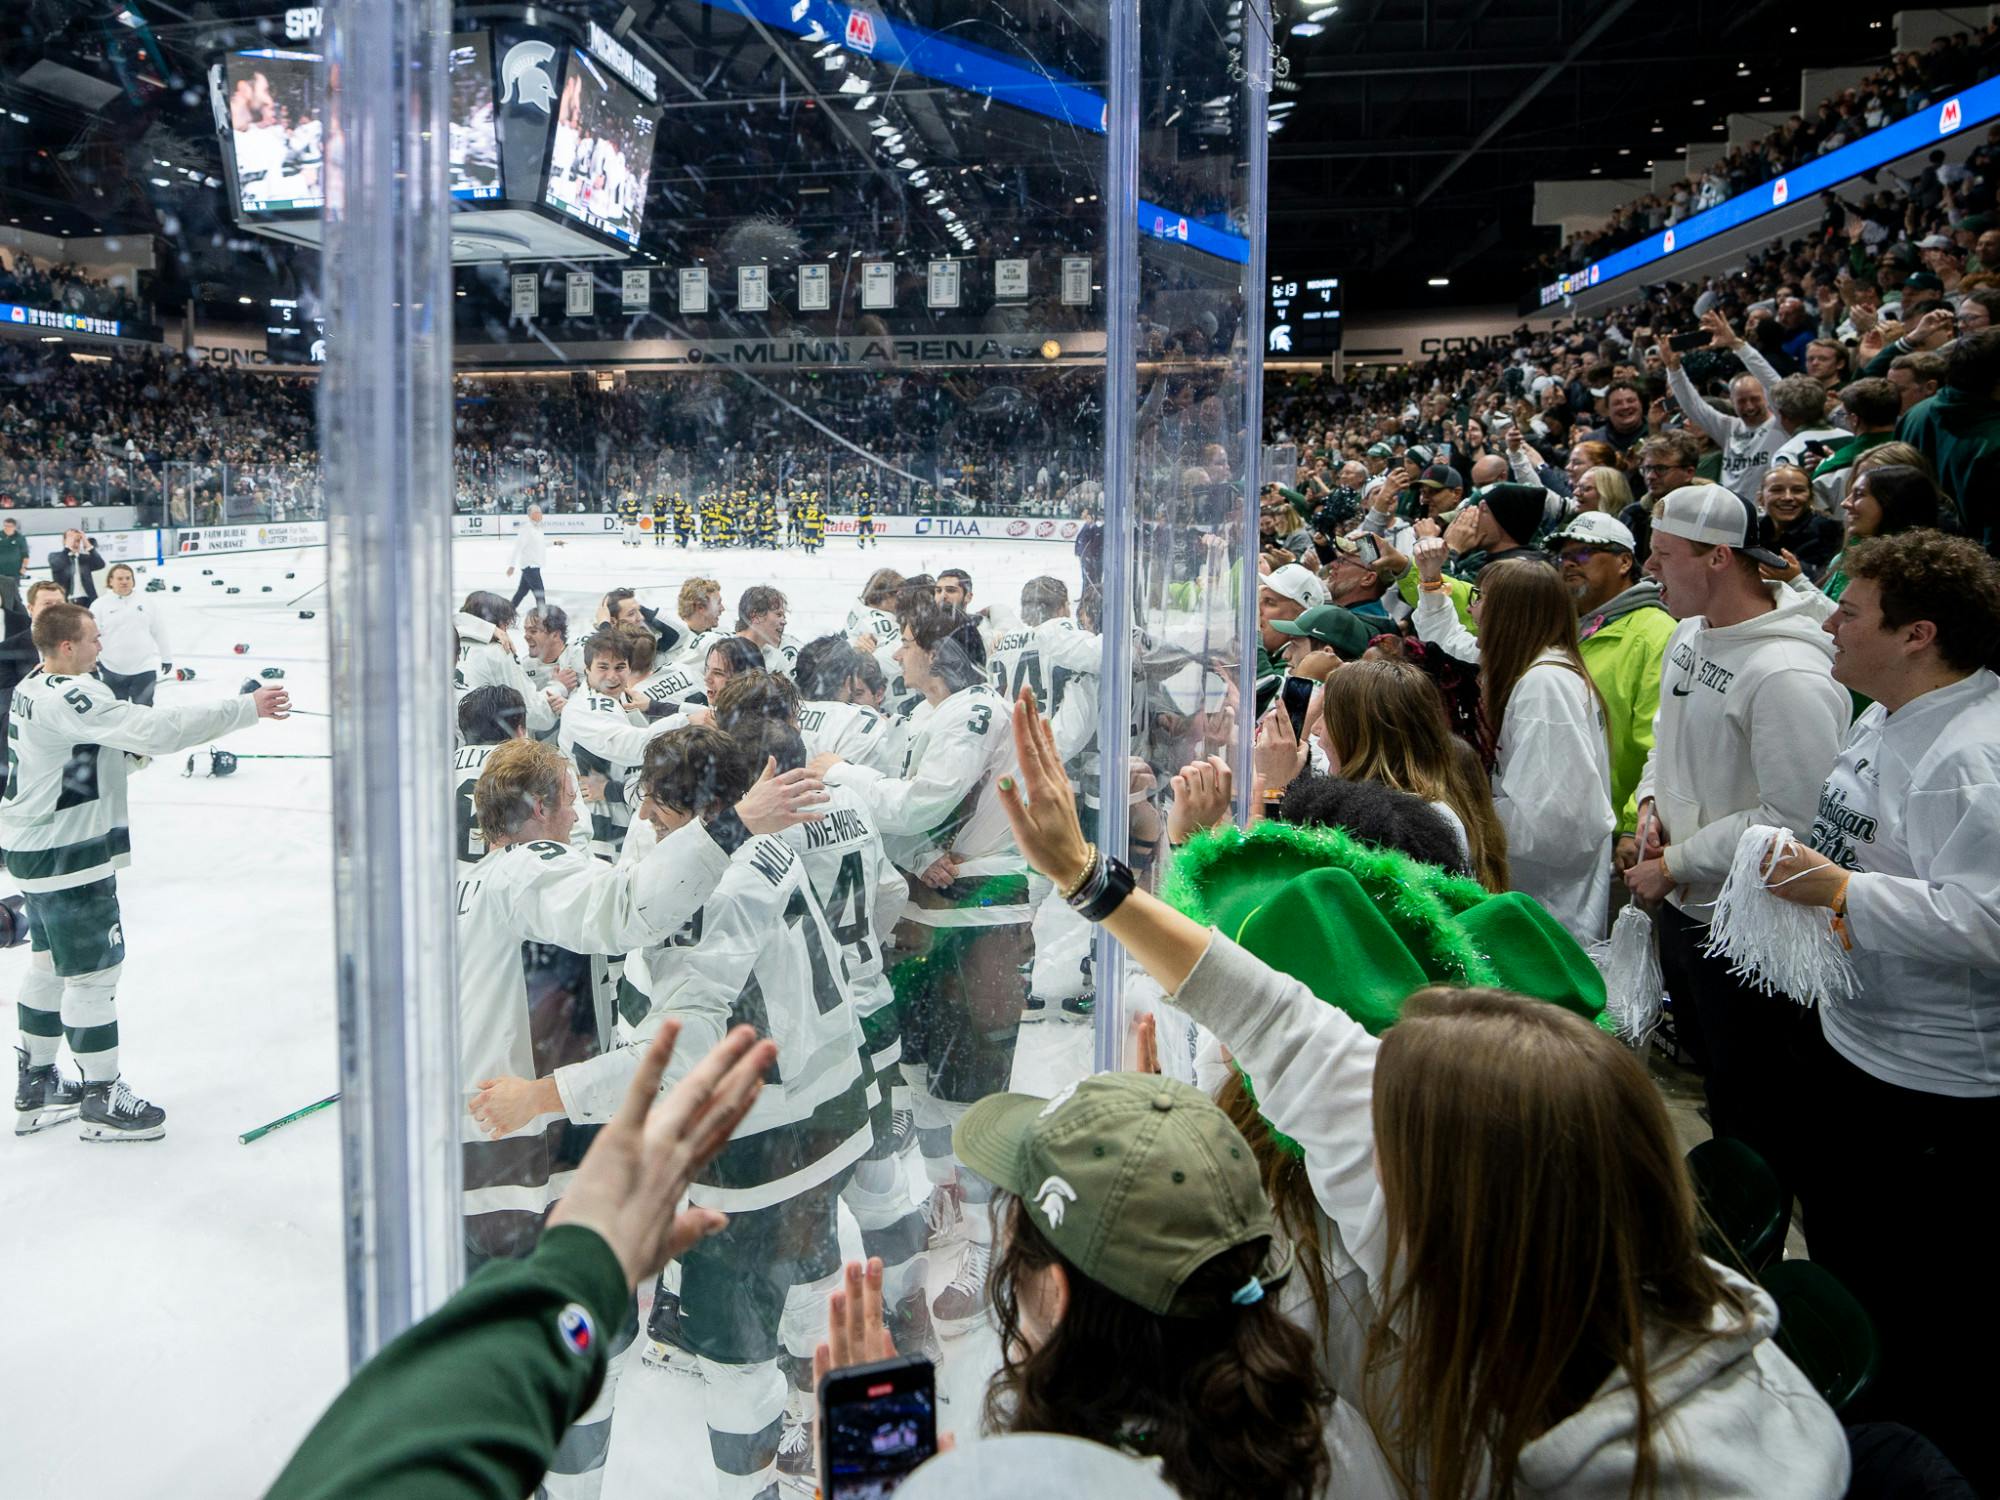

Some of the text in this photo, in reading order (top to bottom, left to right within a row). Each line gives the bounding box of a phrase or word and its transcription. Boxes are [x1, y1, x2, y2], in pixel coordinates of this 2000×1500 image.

[1272, 282, 1298, 298] 6:13
[1320, 289, 1331, 302] 4
[283, 308, 292, 321] 5
[1277, 309, 1286, 320] 4
[734, 340, 1006, 363] MUNN ARENA
[936, 519, 980, 535] TIAA
[872, 619, 892, 634] 10
[1697, 660, 1734, 695] STATE
[64, 687, 93, 715] 5
[587, 697, 615, 713] 12
[860, 710, 878, 734] 7
[967, 704, 993, 736] 3
